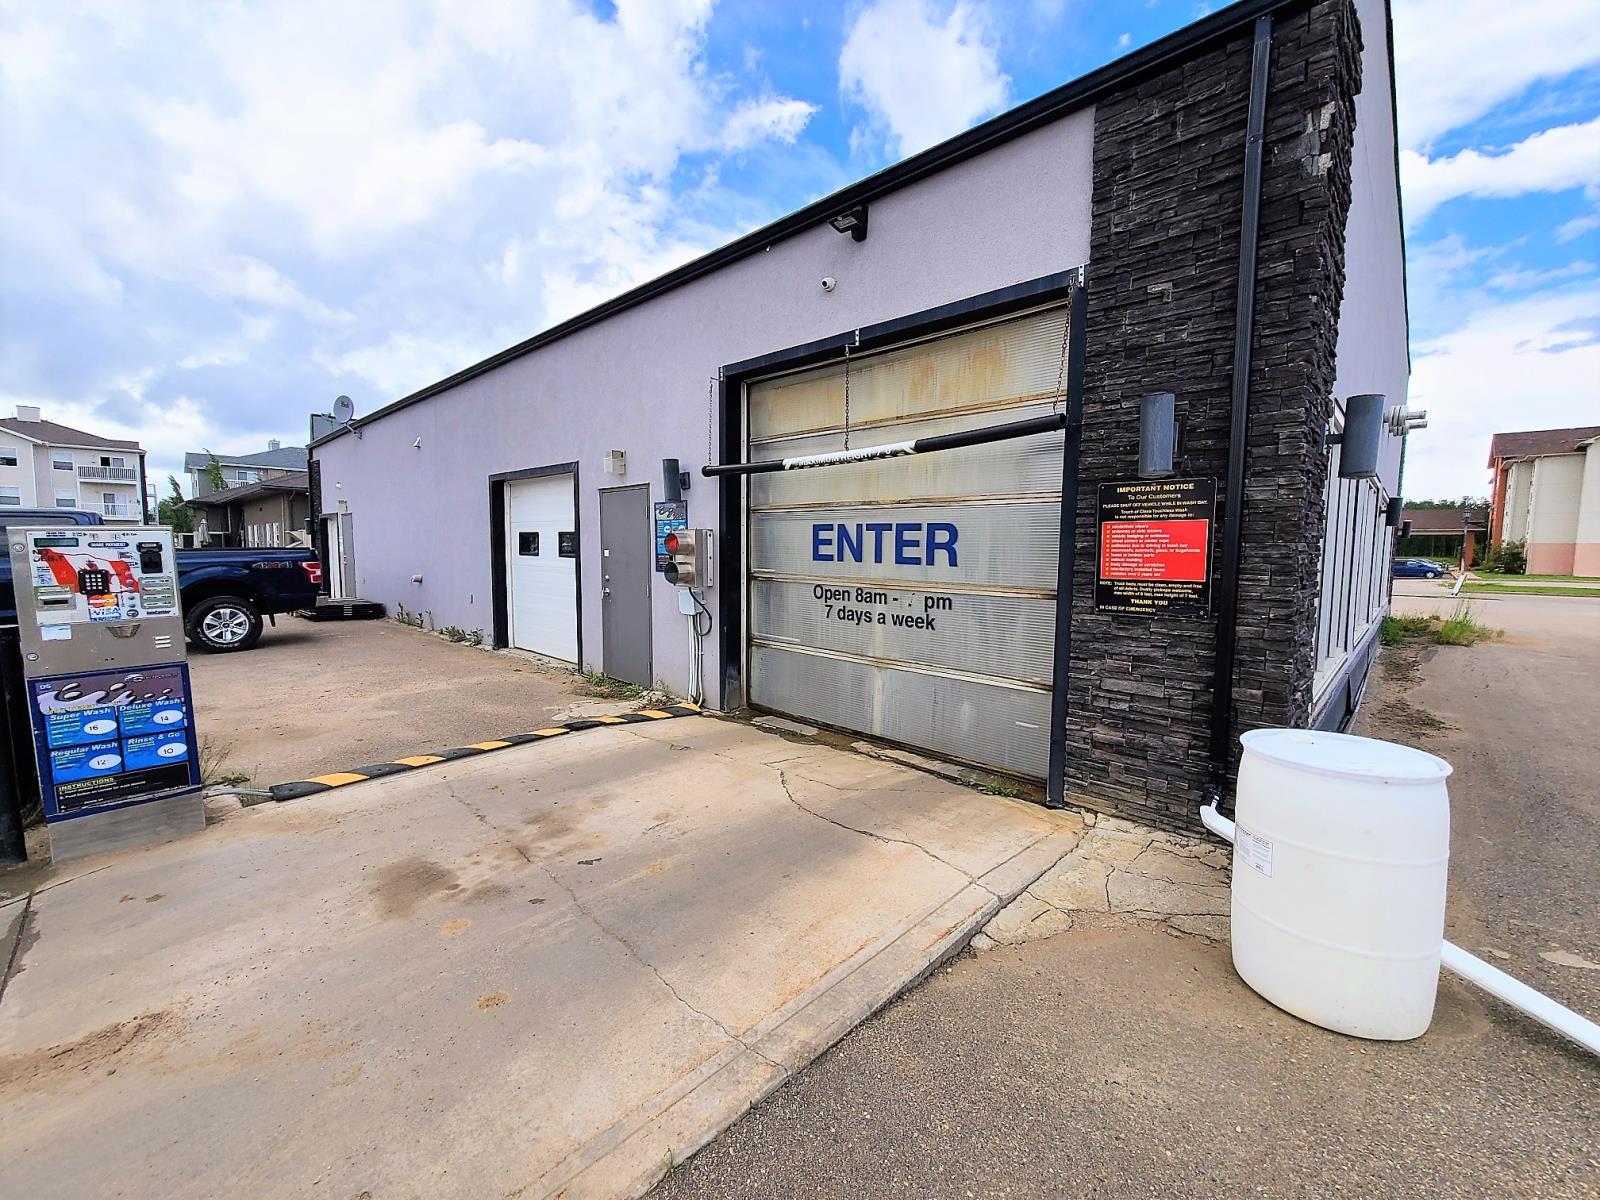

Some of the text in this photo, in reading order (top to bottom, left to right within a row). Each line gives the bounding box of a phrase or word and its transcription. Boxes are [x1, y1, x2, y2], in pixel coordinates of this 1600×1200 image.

[840, 452, 872, 462] HEIGHT
[1117, 483, 1194, 493] IMPORTANT NOTICE
[812, 522, 958, 567] ENTER
[813, 584, 851, 603] Open
[855, 587, 887, 605] 8am
[924, 595, 953, 613] pm
[824, 604, 936, 631] 7 days a week
[119, 702, 153, 712] Deluxe
[155, 698, 181, 707] Wash
[50, 712, 81, 722] Super
[83, 707, 111, 717] Wash
[89, 724, 99, 732] 16
[127, 736, 155, 745] Rinse
[51, 747, 90, 758] Regular
[91, 741, 118, 751] Wash
[163, 747, 174, 755] 10
[58, 777, 115, 792] INSTRUCTIONS
